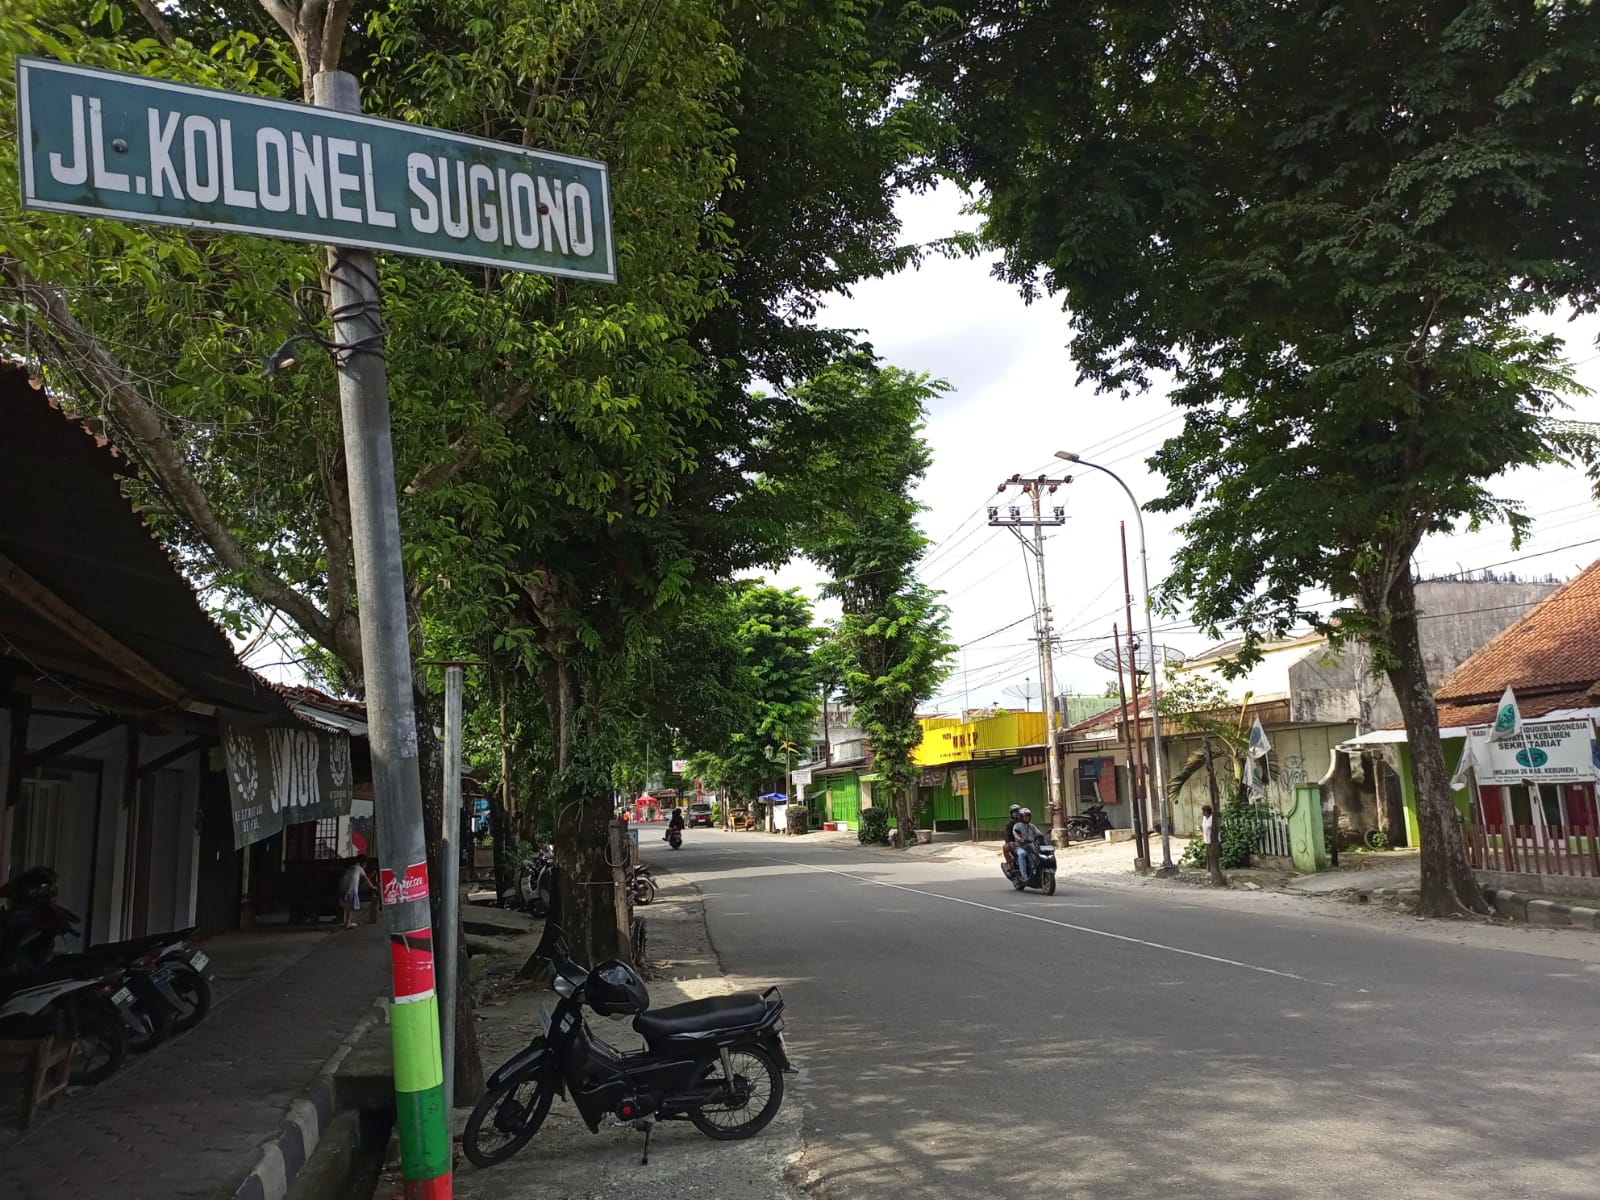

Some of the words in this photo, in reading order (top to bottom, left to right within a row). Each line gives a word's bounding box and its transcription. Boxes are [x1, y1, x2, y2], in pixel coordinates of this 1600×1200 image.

[407, 152, 594, 257] SUGIONO
[1550, 723, 1587, 732] INDONESIA
[1533, 731, 1571, 740] KEBUMEN
[1544, 766, 1574, 774] KEBUMEN
